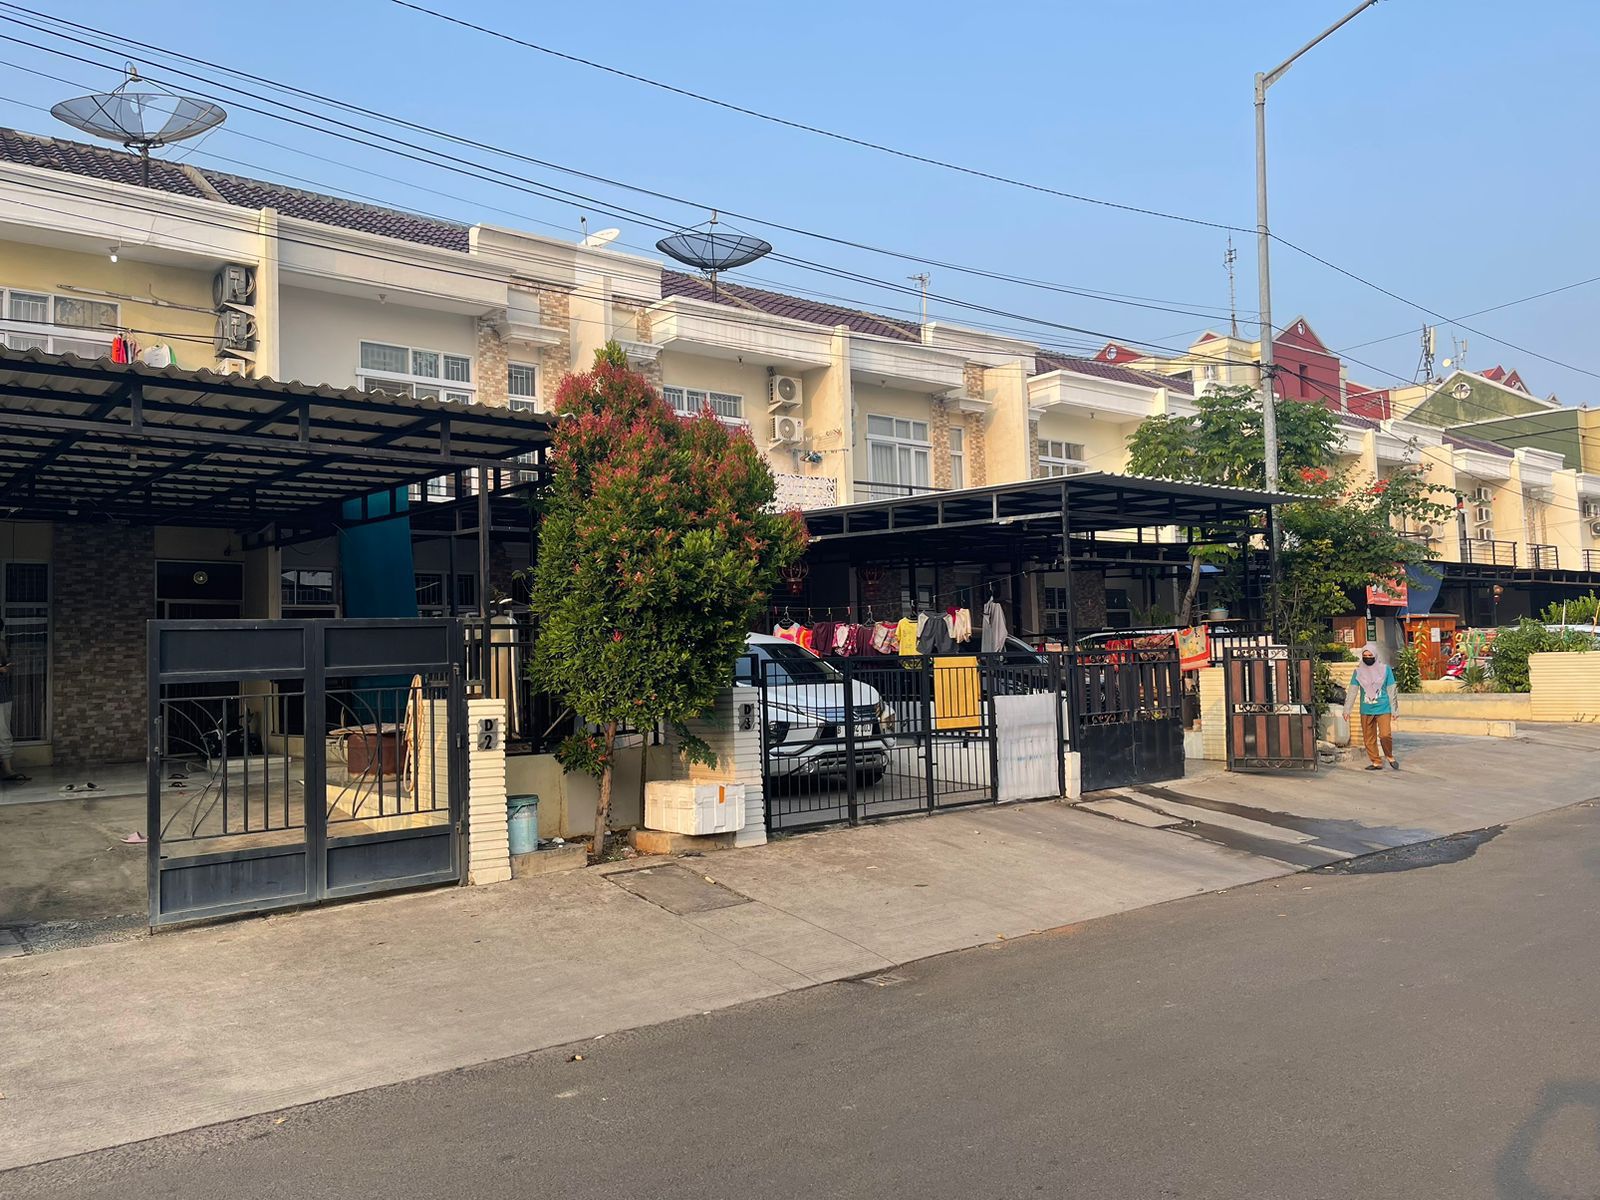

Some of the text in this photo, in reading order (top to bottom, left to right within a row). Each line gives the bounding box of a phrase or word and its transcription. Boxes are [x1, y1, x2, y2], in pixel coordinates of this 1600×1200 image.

[744, 704, 751, 715] D
[484, 719, 493, 731] D
[744, 718, 751, 730] 3
[484, 734, 492, 750] 2
